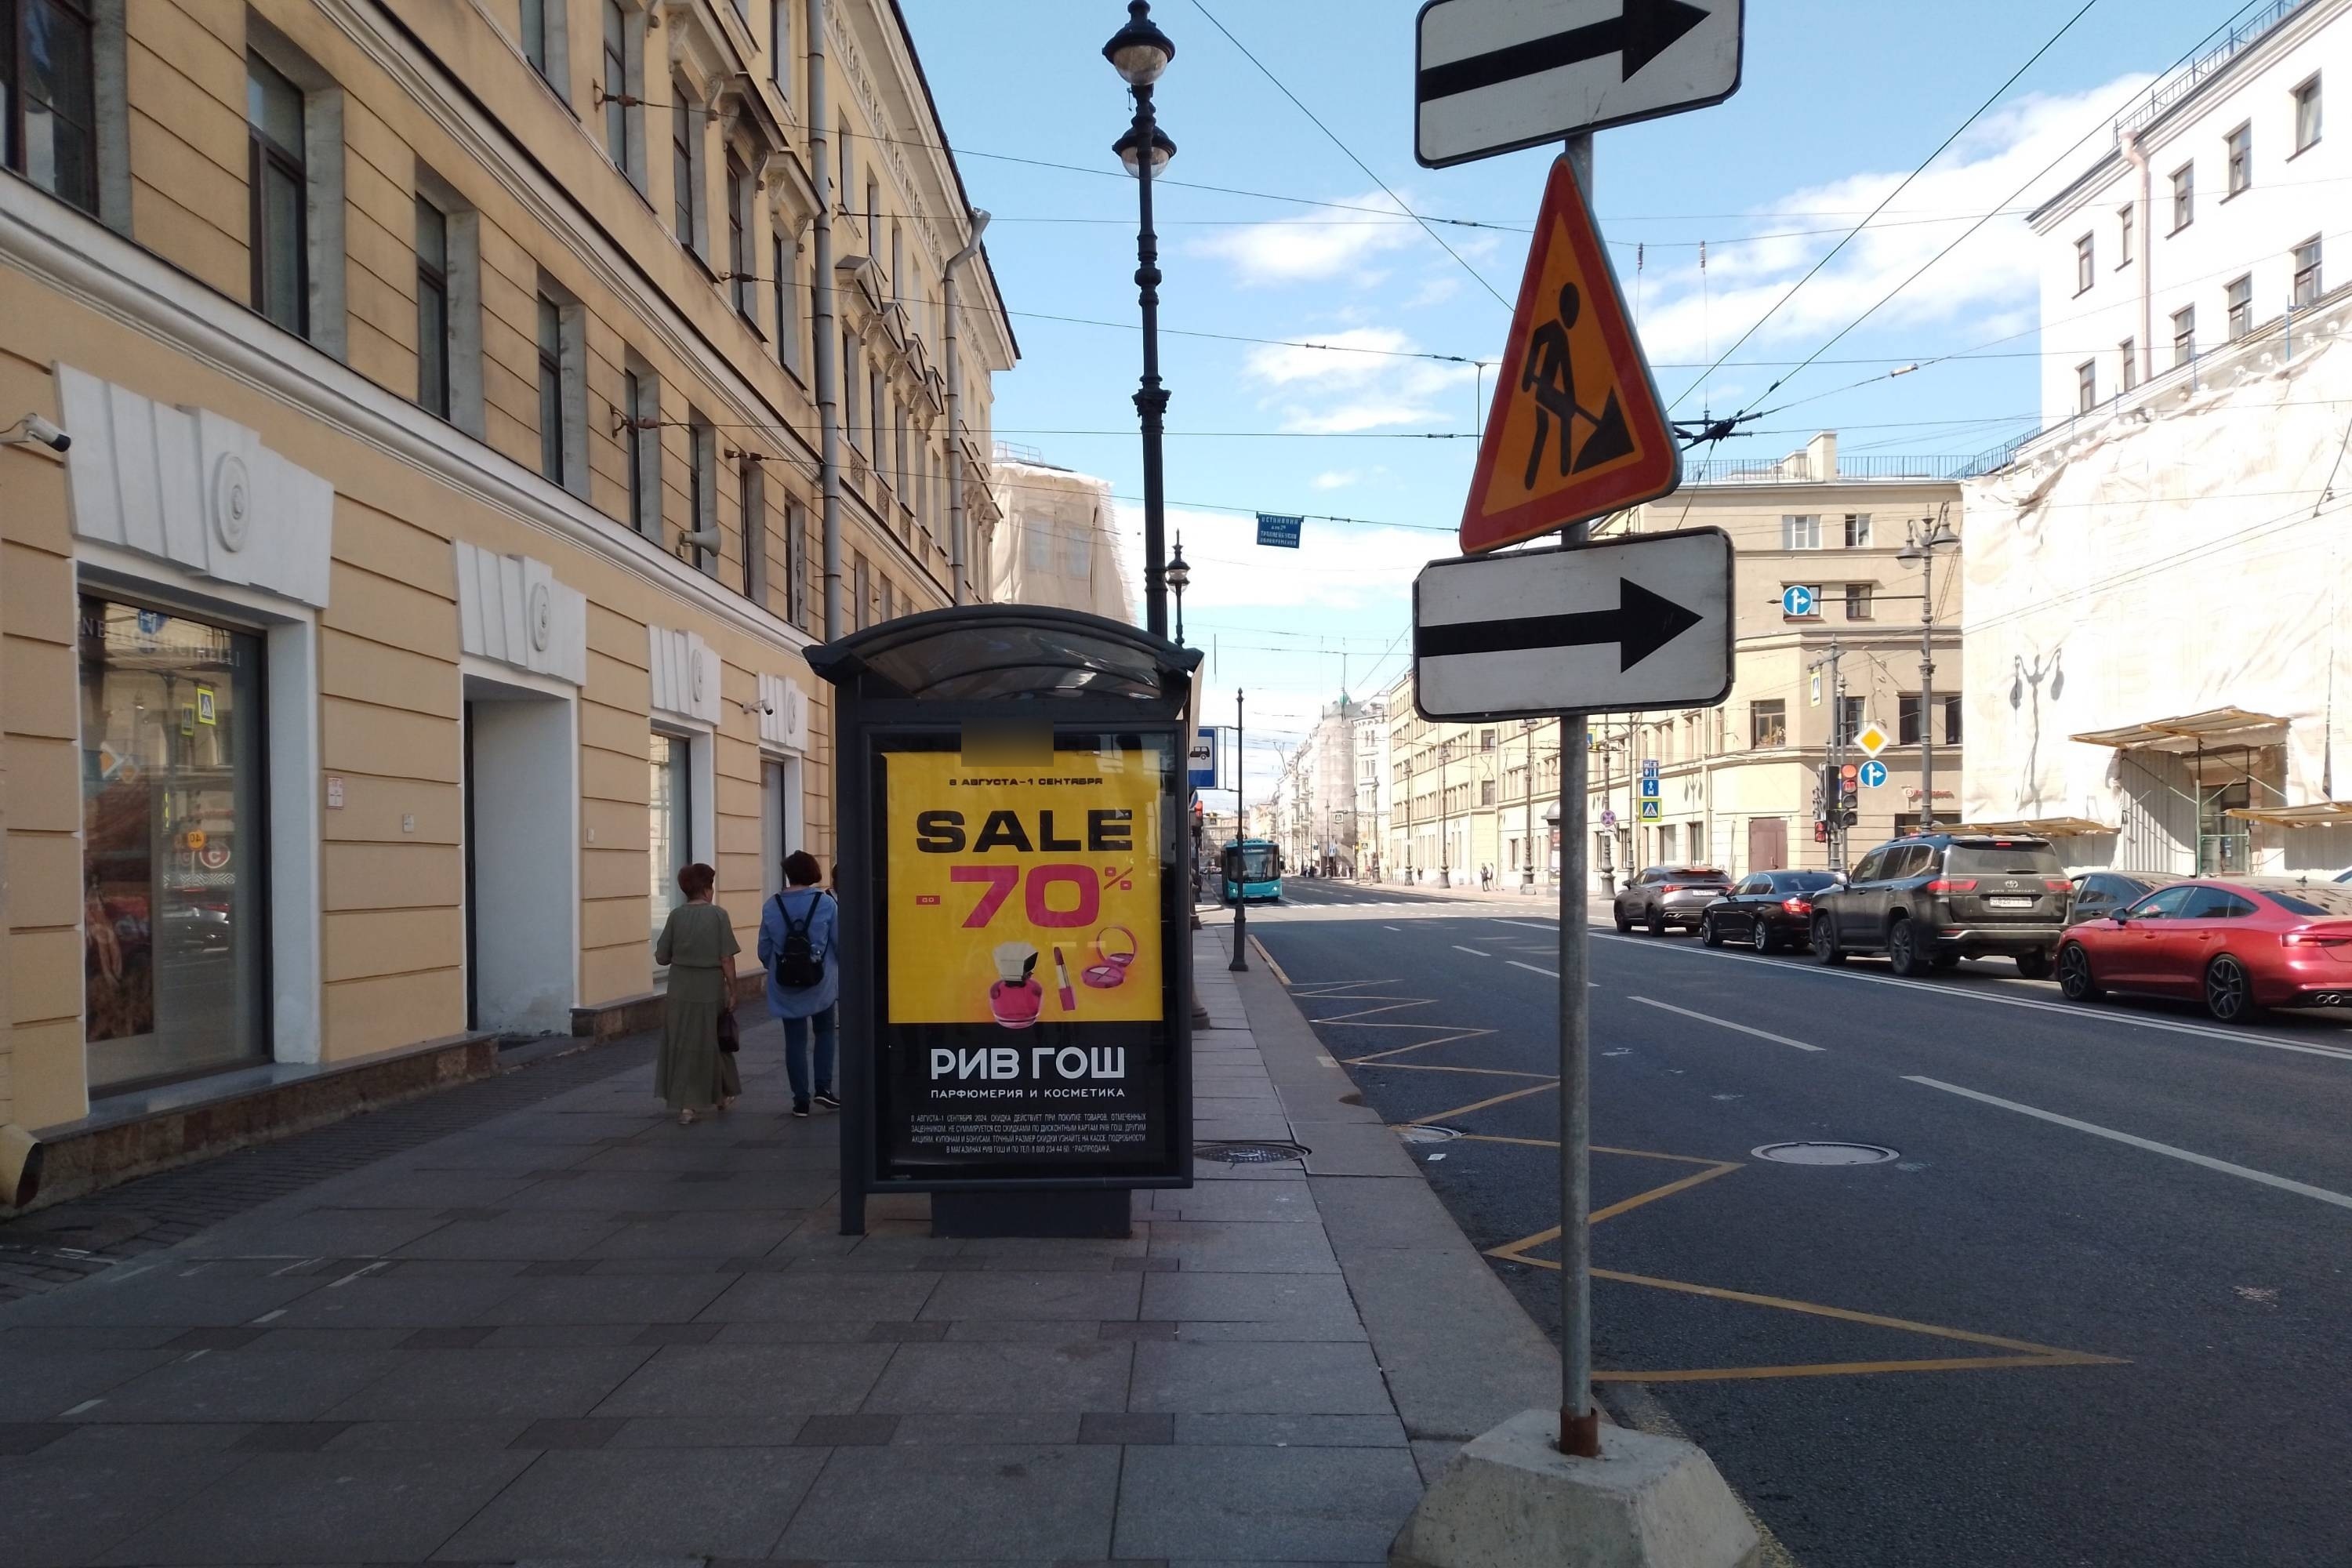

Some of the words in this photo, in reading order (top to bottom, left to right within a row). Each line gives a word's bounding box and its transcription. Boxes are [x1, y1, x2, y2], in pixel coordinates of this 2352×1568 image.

[916, 810, 1133, 853] SALE
[931, 1047, 1020, 1080] РИВ
[1032, 1047, 1125, 1080] ГОШ
[931, 1089, 1023, 1099] ПАРФЮМЕРИЯ
[1029, 1089, 1038, 1098] И
[1044, 1087, 1125, 1098] КОСМЕТИКА
[991, 1114, 1011, 1123] СКИДКА
[1013, 1113, 1042, 1123] ДЕЙСТВУЕТ
[1111, 1112, 1146, 1121] ОТМЕЧЕННЫХ
[1003, 1124, 1031, 1133] СКИДКАМИ
[1036, 1134, 1058, 1143] СКИДКИ
[1108, 1134, 1145, 1142] ПОДРОБНОСТИ
